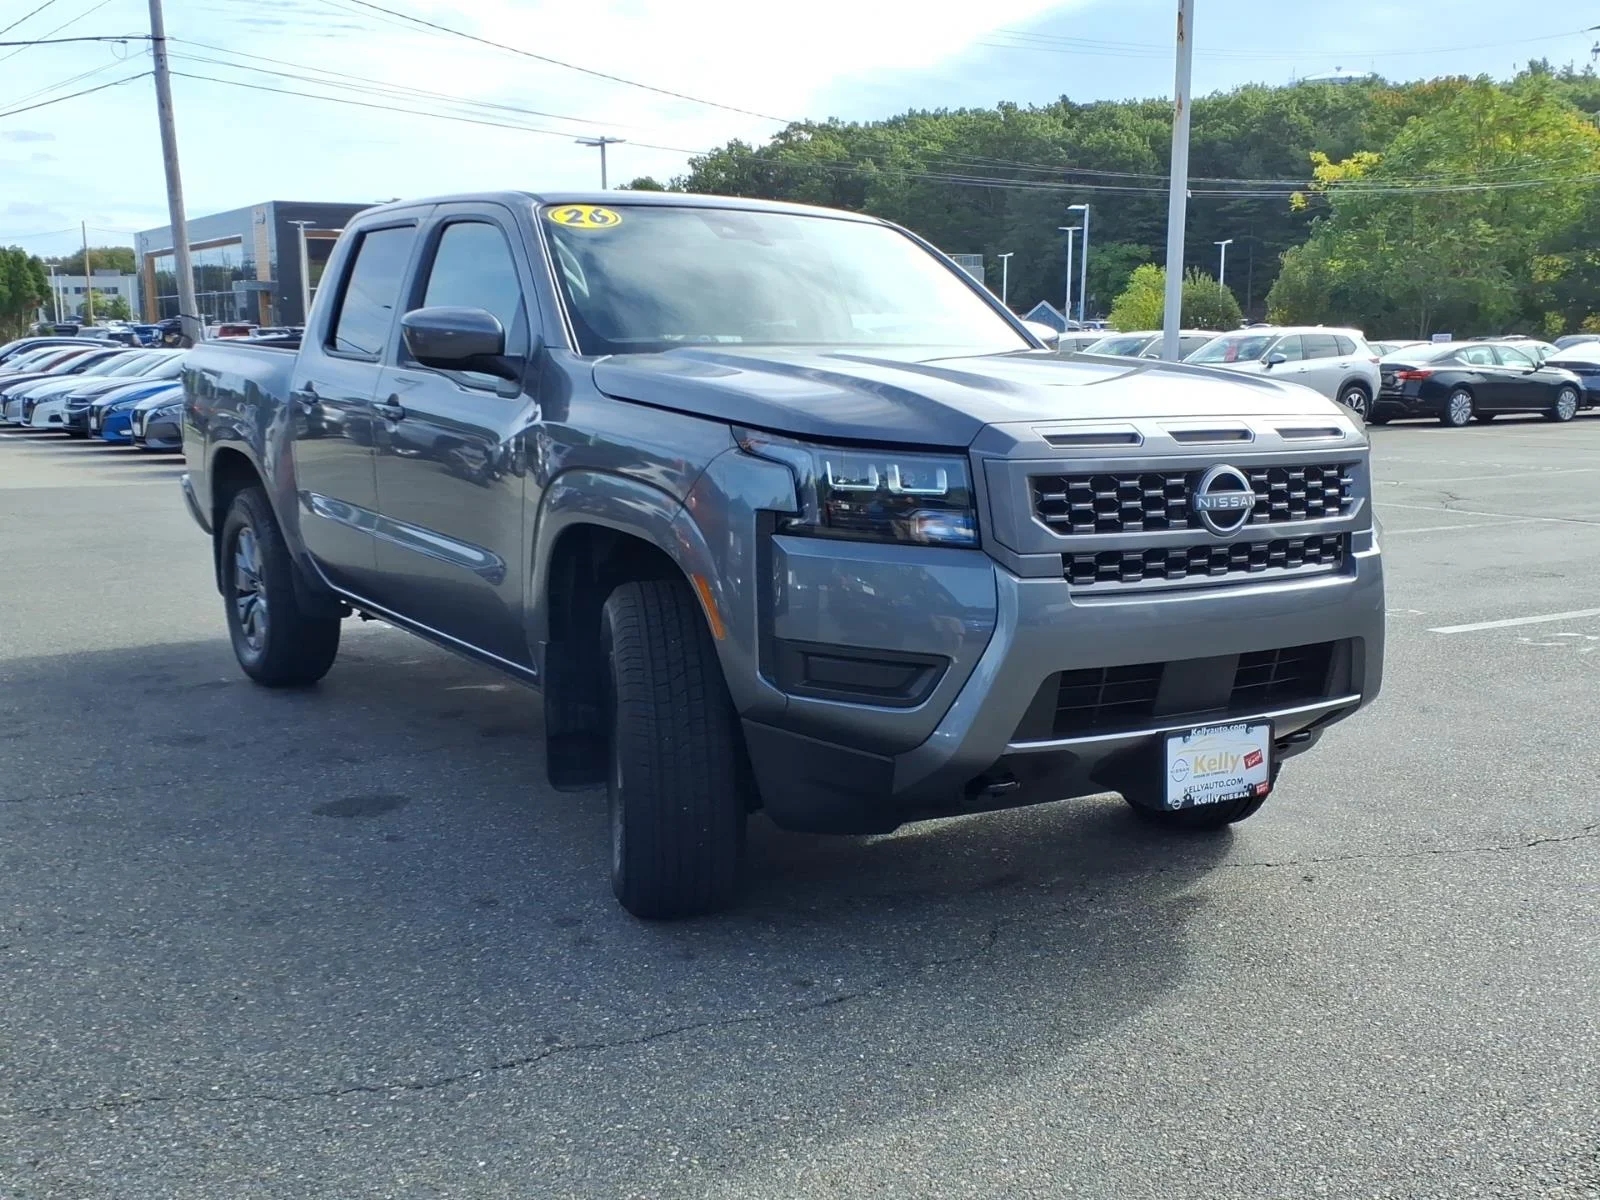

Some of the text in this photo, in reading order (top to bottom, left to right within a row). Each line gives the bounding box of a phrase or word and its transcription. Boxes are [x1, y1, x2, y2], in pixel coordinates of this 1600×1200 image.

[563, 208, 609, 223] 26
[1198, 495, 1255, 508] NISSAN
[1191, 723, 1247, 737] Kellyauto.com
[1193, 752, 1241, 775] Kelly
[1183, 777, 1244, 795] KELLYAUTO.COM
[1193, 791, 1250, 806] Kelly NISSAN
